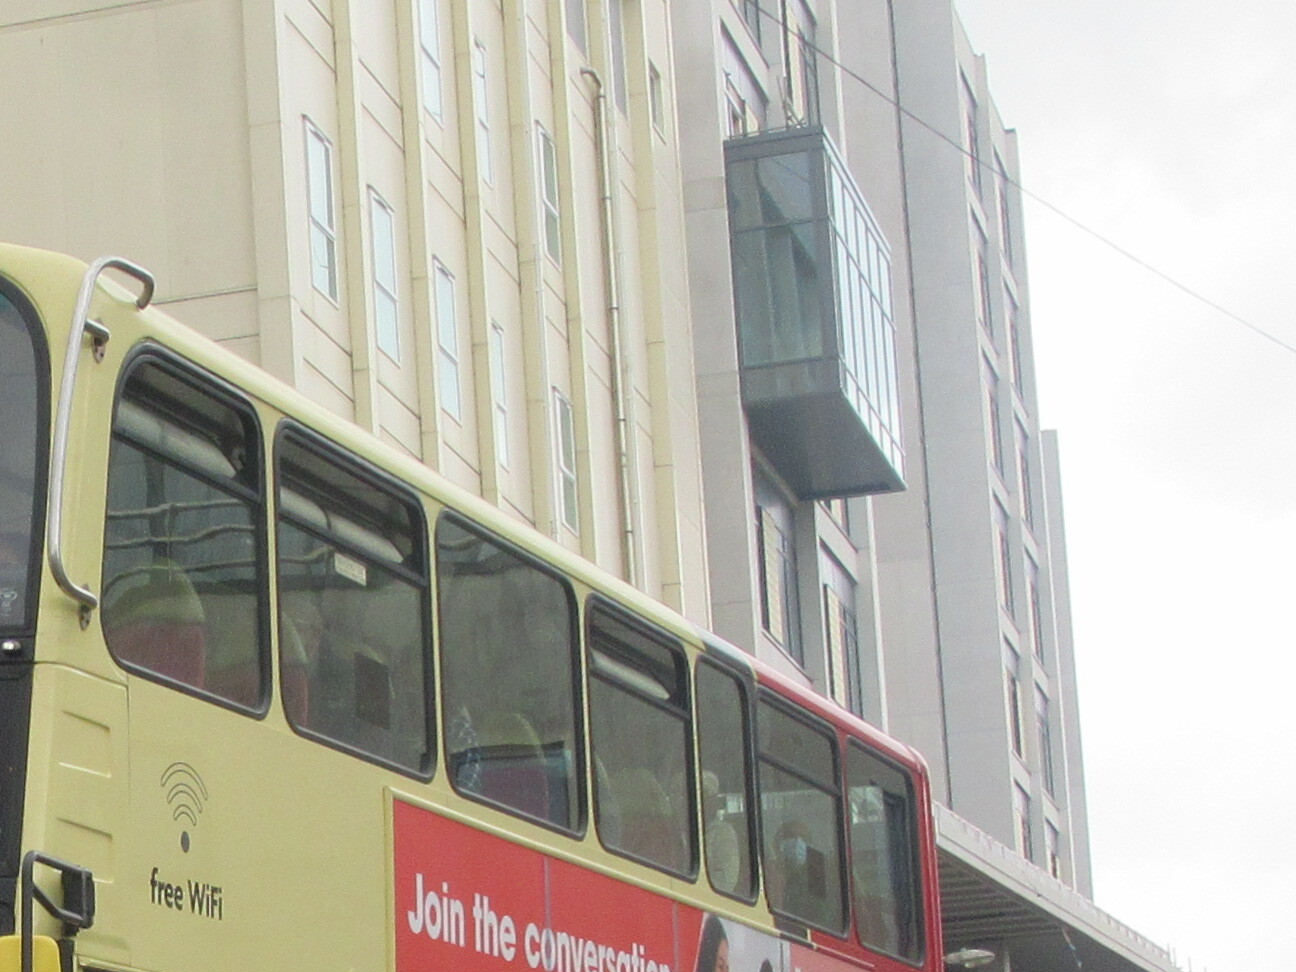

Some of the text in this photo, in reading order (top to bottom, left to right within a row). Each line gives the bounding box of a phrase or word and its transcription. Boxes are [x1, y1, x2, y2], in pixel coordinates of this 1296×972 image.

[149, 866, 224, 921] free WiFi
[406, 872, 466, 948] Join
[472, 892, 518, 962] the
